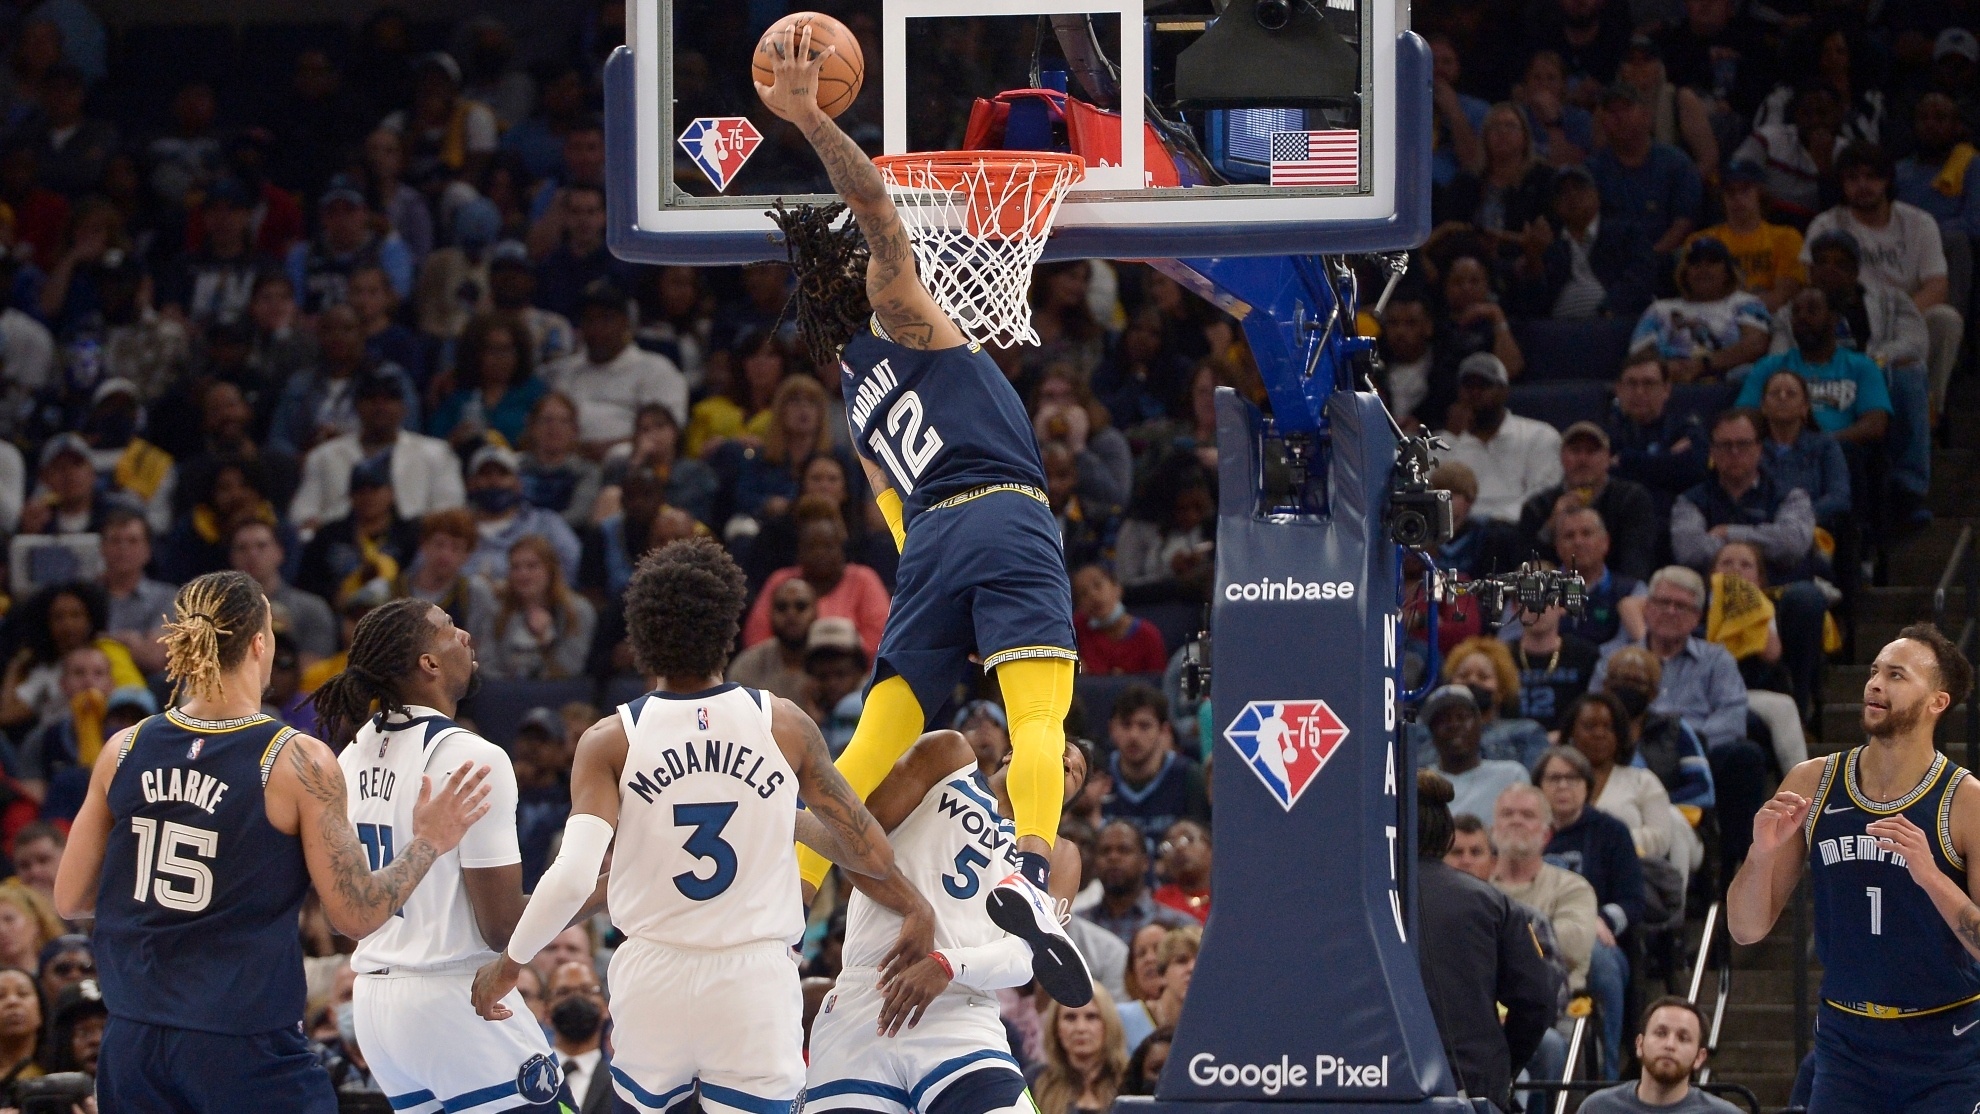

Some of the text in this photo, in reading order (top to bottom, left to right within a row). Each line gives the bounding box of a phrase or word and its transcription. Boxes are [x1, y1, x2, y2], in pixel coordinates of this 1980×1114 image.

[727, 128, 744, 150] 75
[851, 357, 899, 433] MORANT
[868, 390, 944, 496] 12
[1225, 577, 1355, 601] coinbase
[1297, 716, 1321, 749] 75
[141, 768, 230, 815] CLARKE
[359, 767, 396, 802] REID
[627, 739, 785, 805] McDANIELS
[672, 801, 739, 902] 3
[938, 792, 1018, 868] WOLVE
[131, 816, 219, 912] 15
[941, 843, 992, 900] 5
[1866, 886, 1882, 936] 1
[1188, 1052, 1388, 1096] Google Pixel
